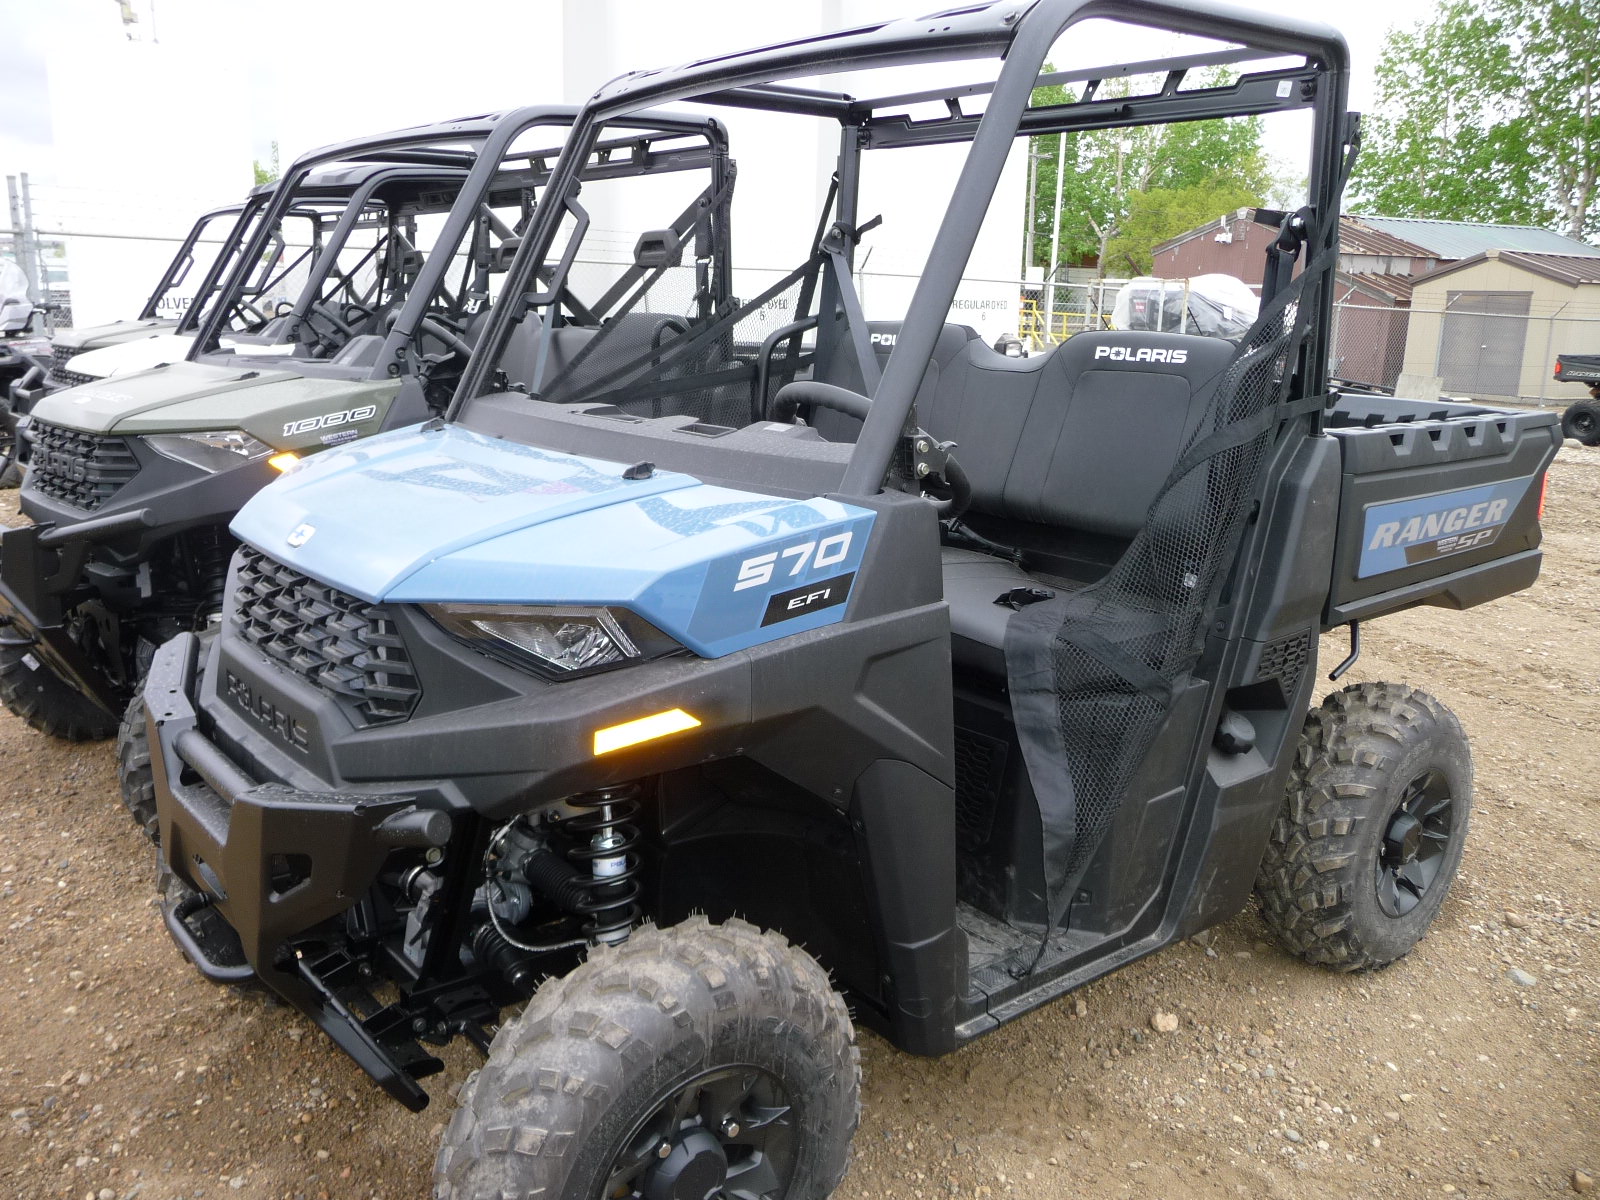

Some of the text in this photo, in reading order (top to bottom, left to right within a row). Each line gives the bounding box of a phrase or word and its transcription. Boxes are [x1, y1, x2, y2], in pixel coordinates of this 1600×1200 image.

[148, 297, 194, 309] OLVE
[870, 333, 896, 346] POL
[1094, 346, 1188, 364] POLARIS
[283, 405, 376, 437] 1000
[1368, 498, 1508, 551] RANGER
[1455, 529, 1493, 550] SP
[734, 531, 853, 592] 570
[787, 588, 831, 610] EFI
[226, 667, 310, 755] POLARIS
